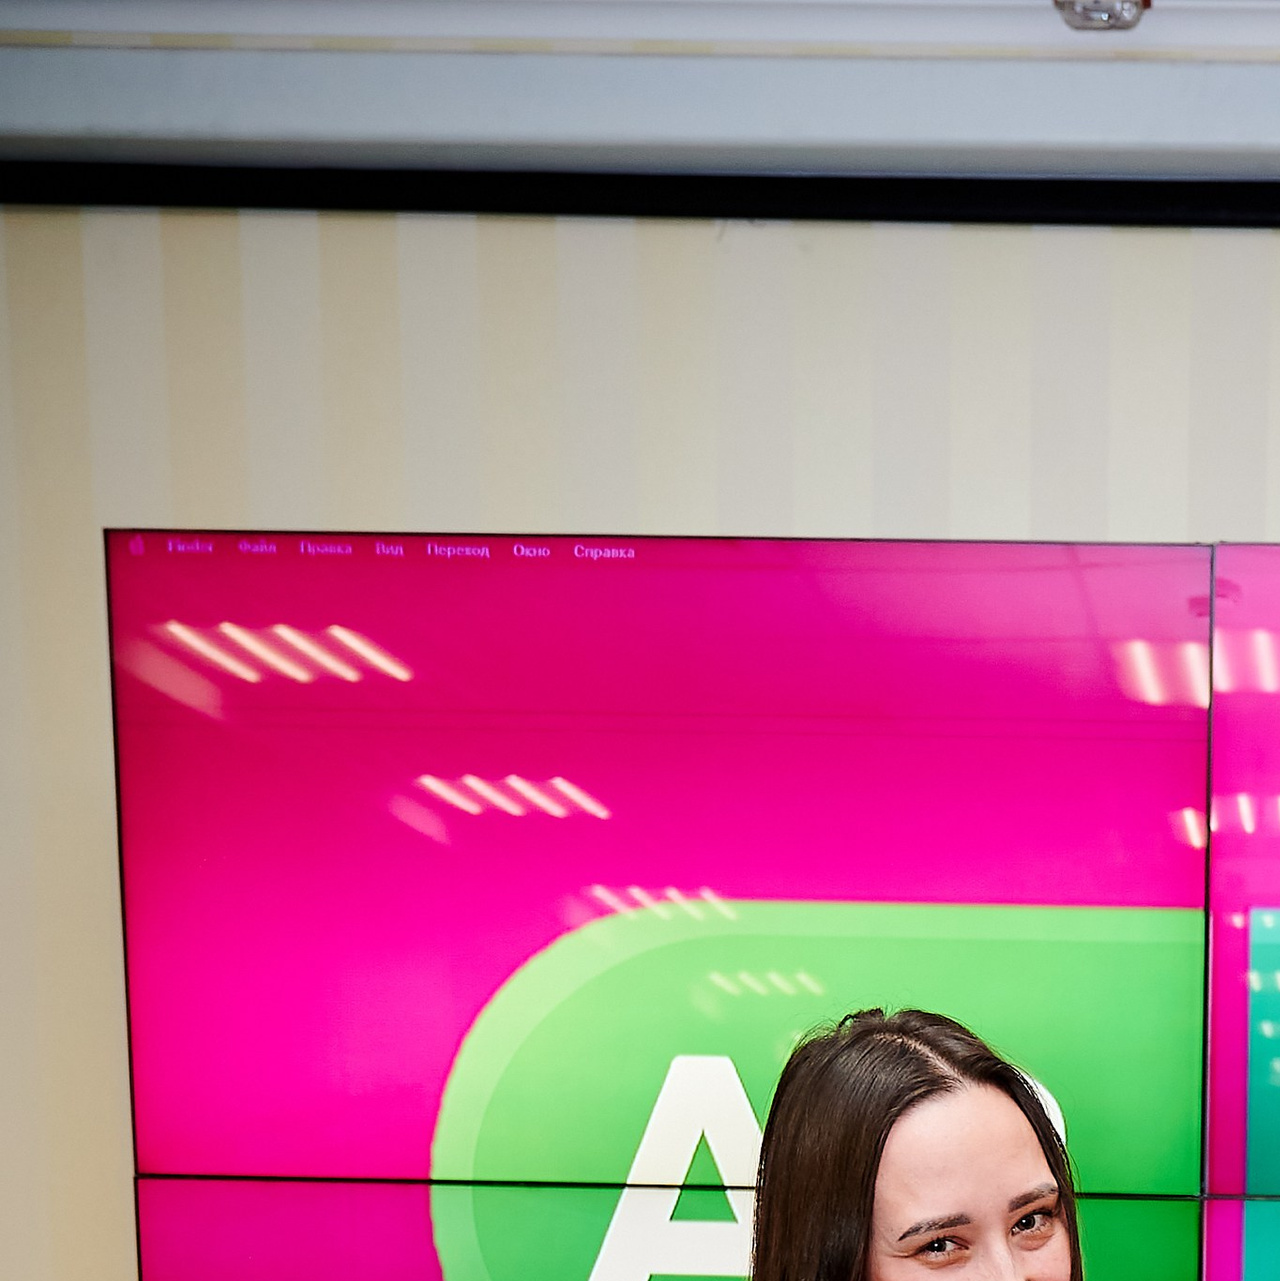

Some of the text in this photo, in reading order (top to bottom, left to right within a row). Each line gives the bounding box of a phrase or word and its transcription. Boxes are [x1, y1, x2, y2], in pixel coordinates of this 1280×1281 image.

[238, 538, 636, 560] Файл Правка Вид Переход Окно Справка
